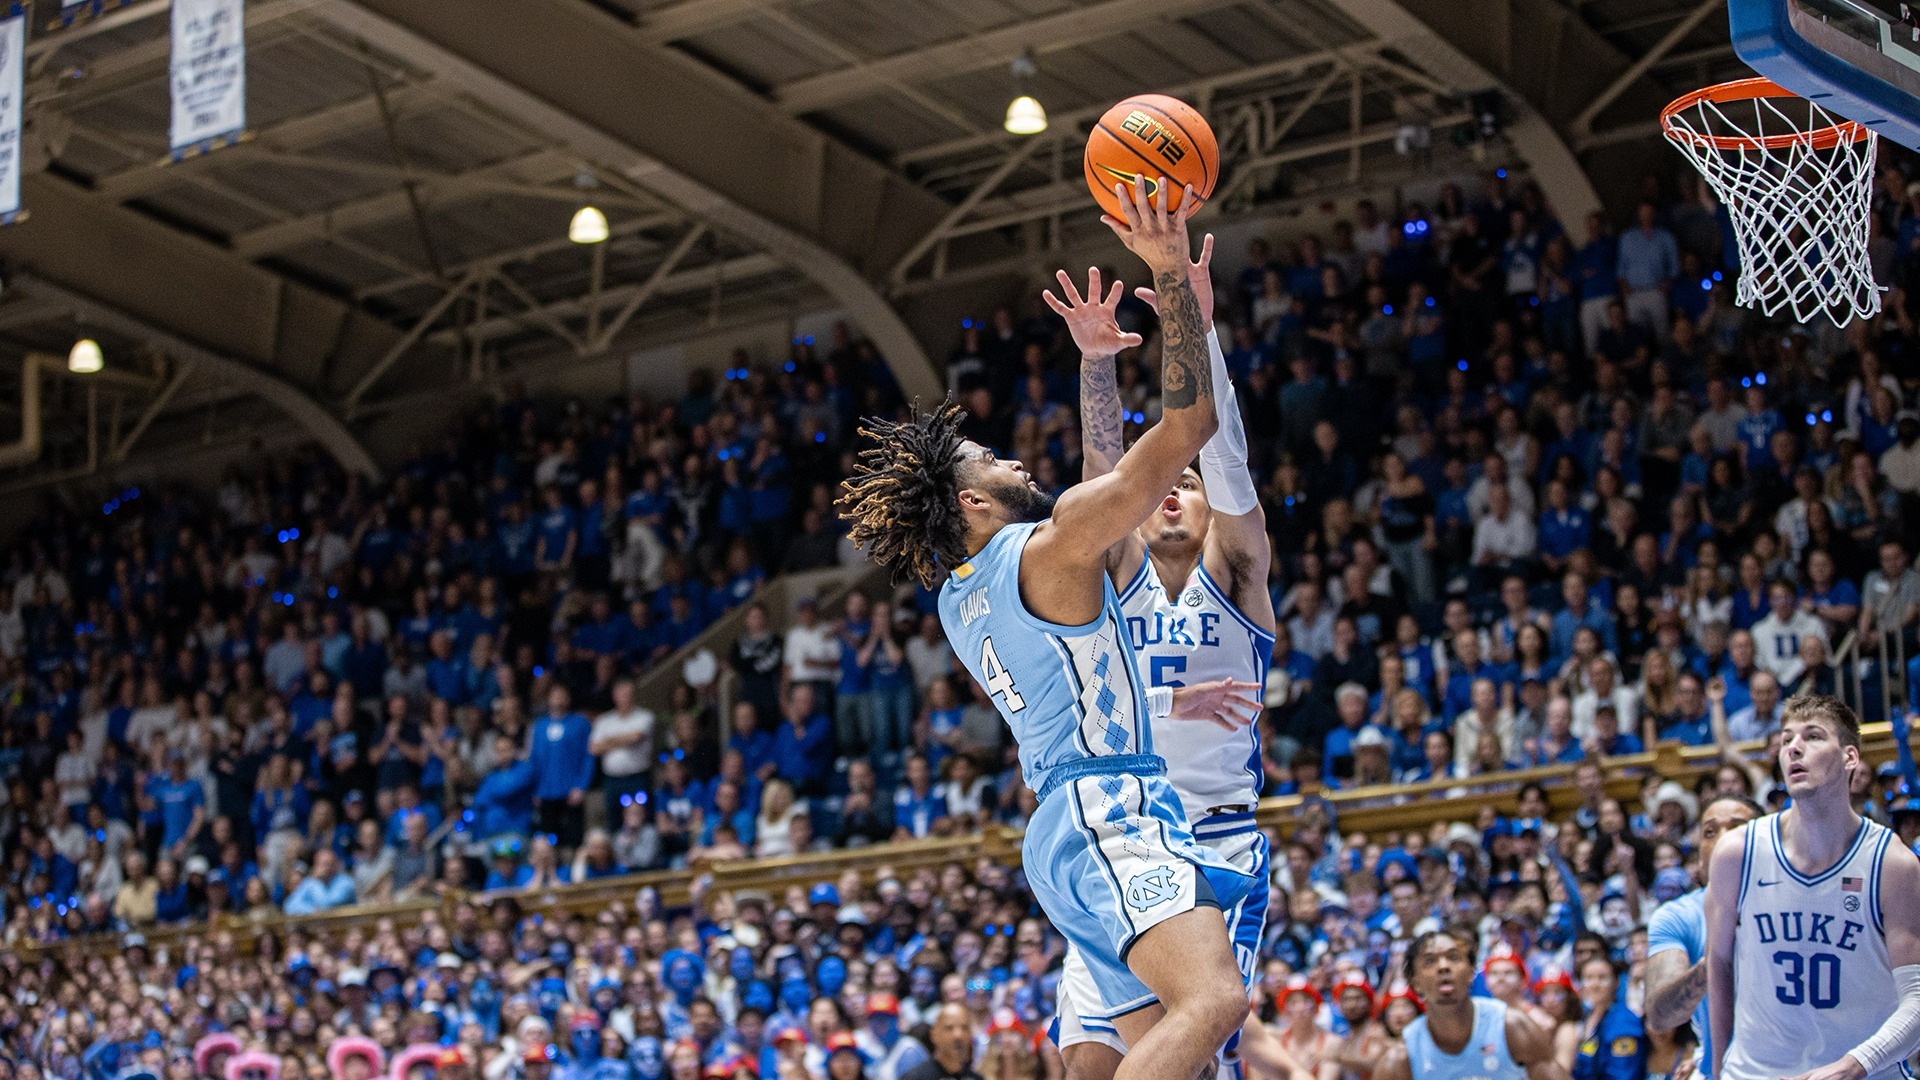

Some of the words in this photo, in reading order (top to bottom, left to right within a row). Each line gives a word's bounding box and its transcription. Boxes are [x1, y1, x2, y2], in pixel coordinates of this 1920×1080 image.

[1120, 114, 1186, 167] ELITE
[959, 586, 991, 628] DAVIS
[1126, 611, 1220, 651] DUKE
[980, 635, 1027, 714] 4
[1753, 912, 1864, 952] DUKE
[1773, 950, 1841, 1009] 30
